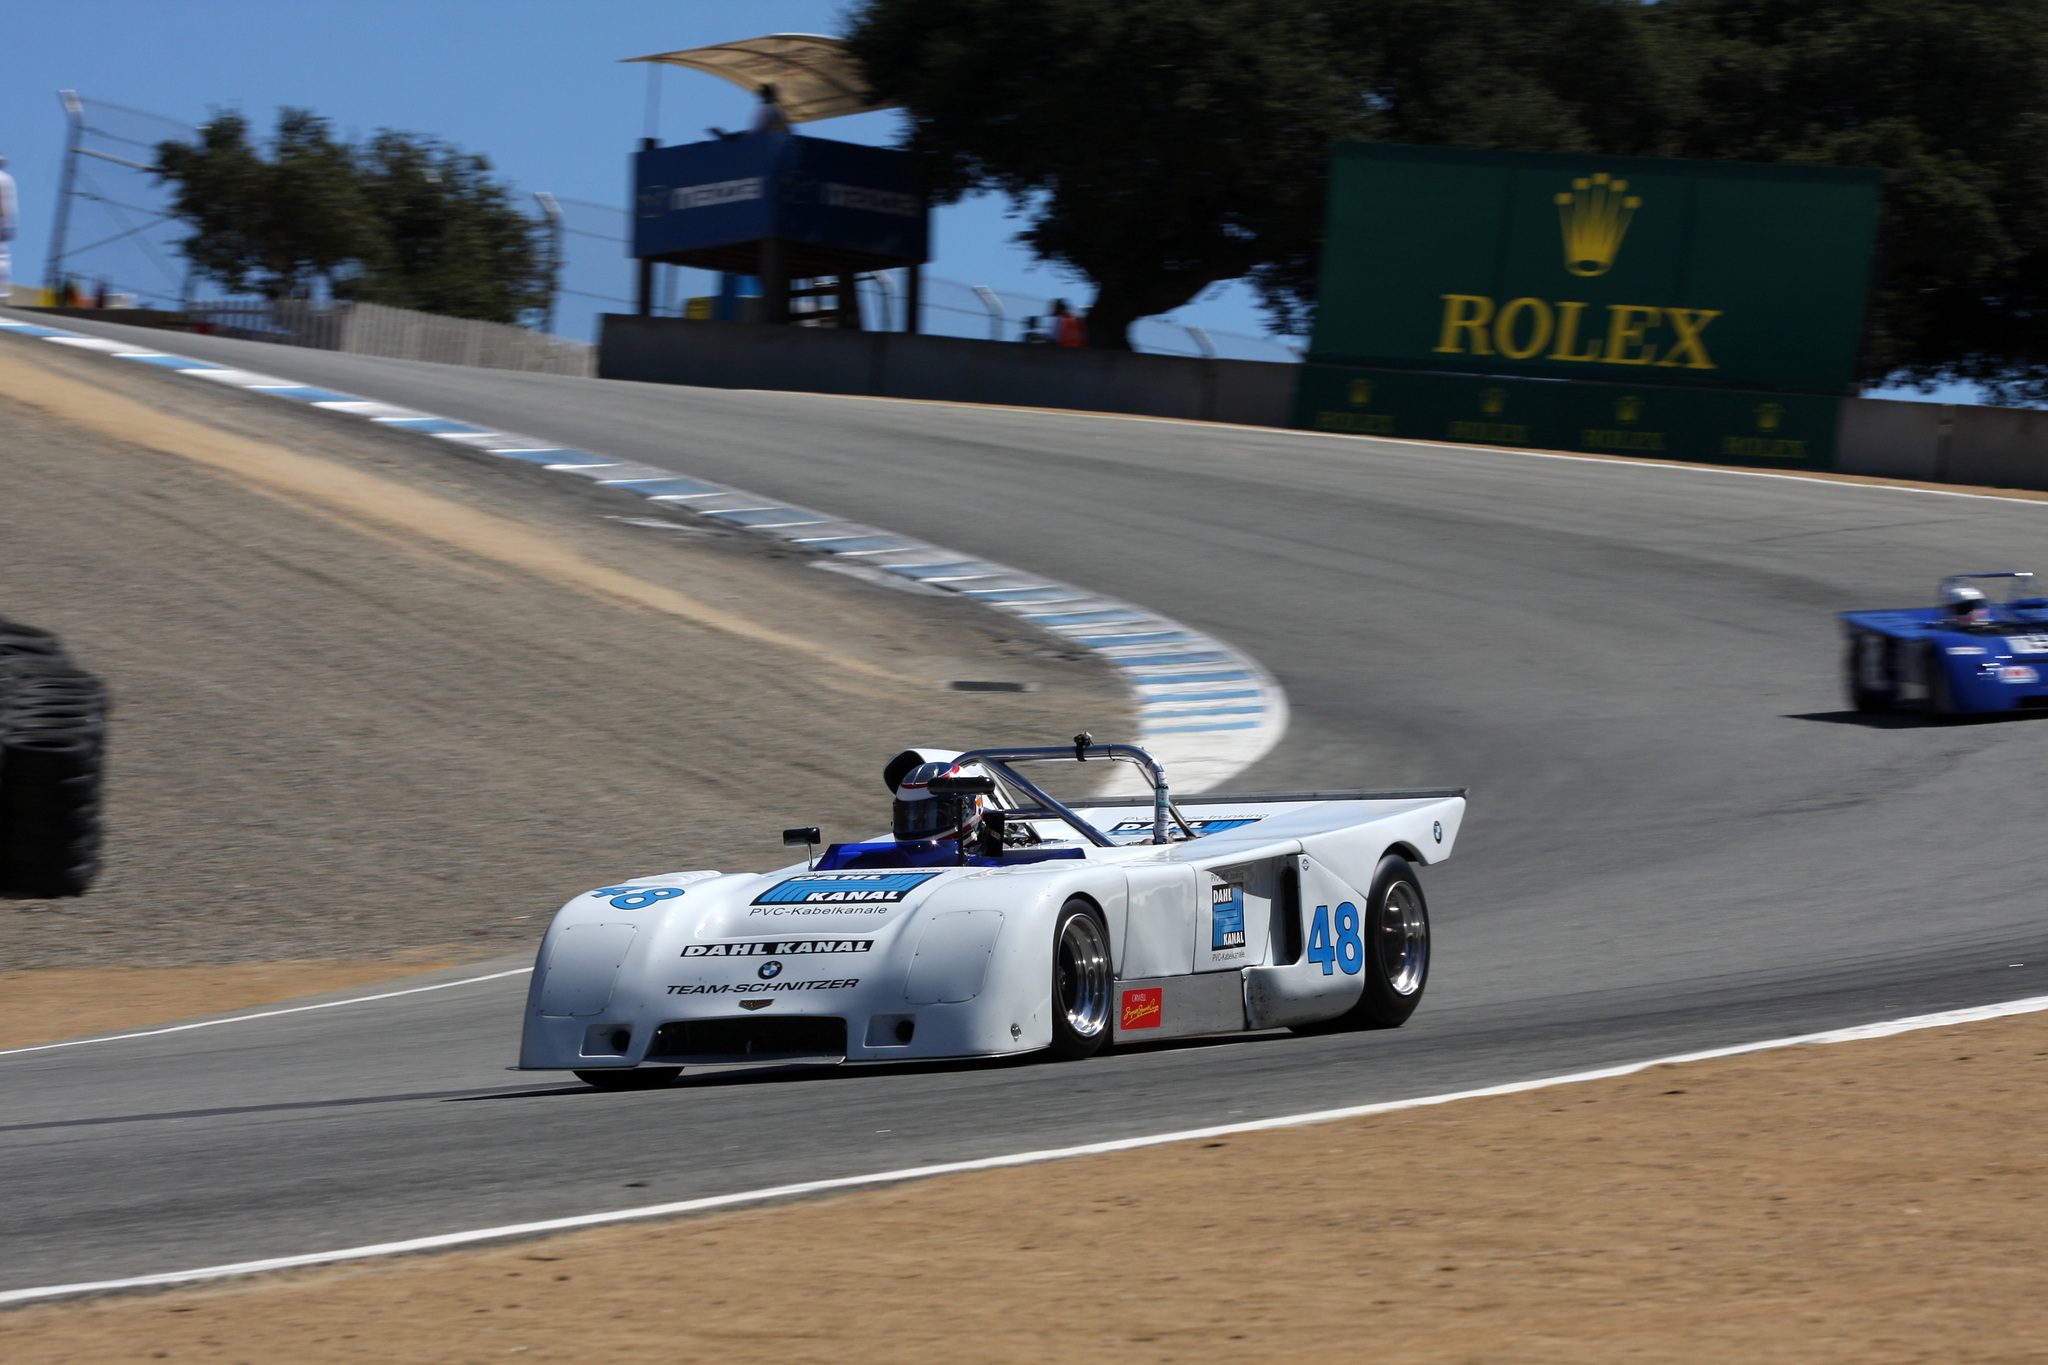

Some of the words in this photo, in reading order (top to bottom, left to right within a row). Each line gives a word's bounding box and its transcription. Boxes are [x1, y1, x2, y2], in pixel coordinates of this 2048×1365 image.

[1432, 294, 1724, 369] ROLEX
[590, 886, 685, 911] 48
[805, 890, 899, 902] KANAL
[1213, 888, 1233, 904] DAHL
[749, 906, 888, 917] PVC-Kabelkanale
[1223, 931, 1245, 946] KANAL
[1308, 901, 1363, 976] 48
[683, 943, 769, 957] DAHL
[774, 941, 871, 954] KANAL
[666, 978, 860, 995] TEAM-SCHNITZER
